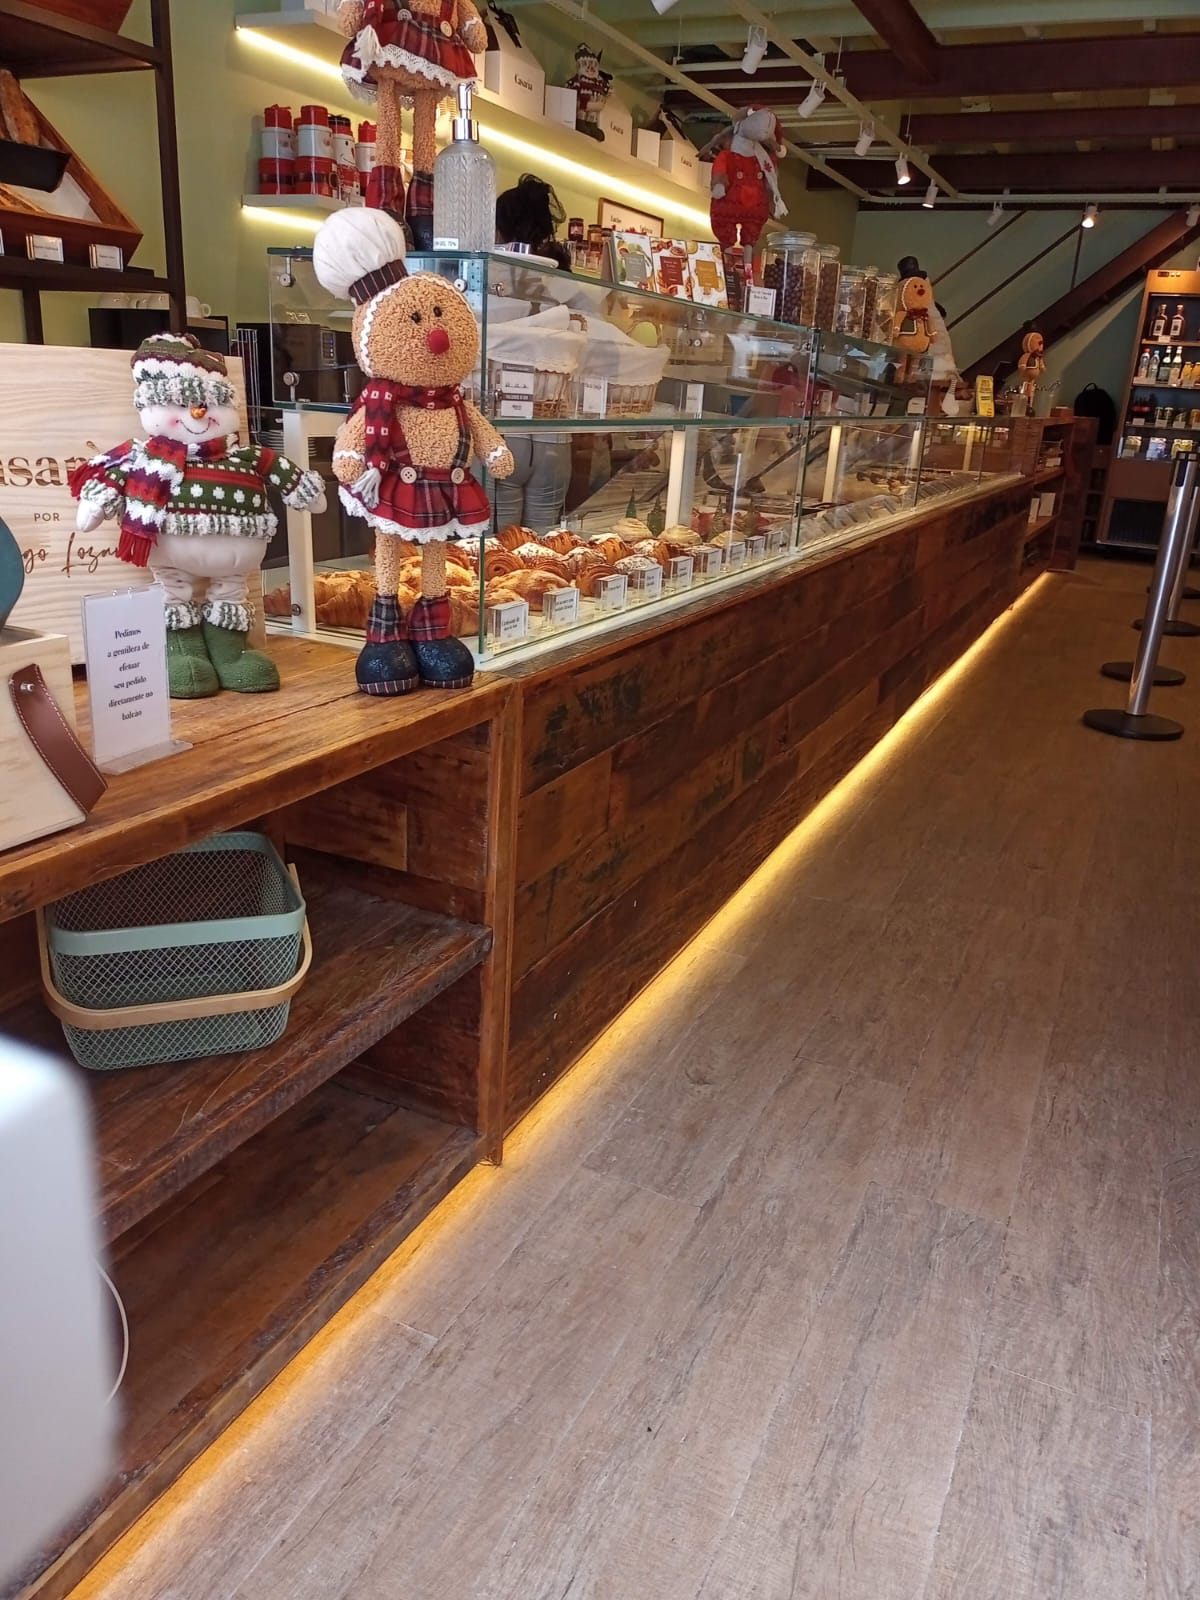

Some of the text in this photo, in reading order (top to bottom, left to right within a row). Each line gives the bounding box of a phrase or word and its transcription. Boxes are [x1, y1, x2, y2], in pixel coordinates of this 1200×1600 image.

[34, 513, 60, 521] POR
[114, 629, 142, 639] Pedimos
[142, 642, 150, 651] de
[119, 662, 141, 672] efetuar
[126, 676, 147, 688] pedido
[108, 693, 145, 708] diretamente
